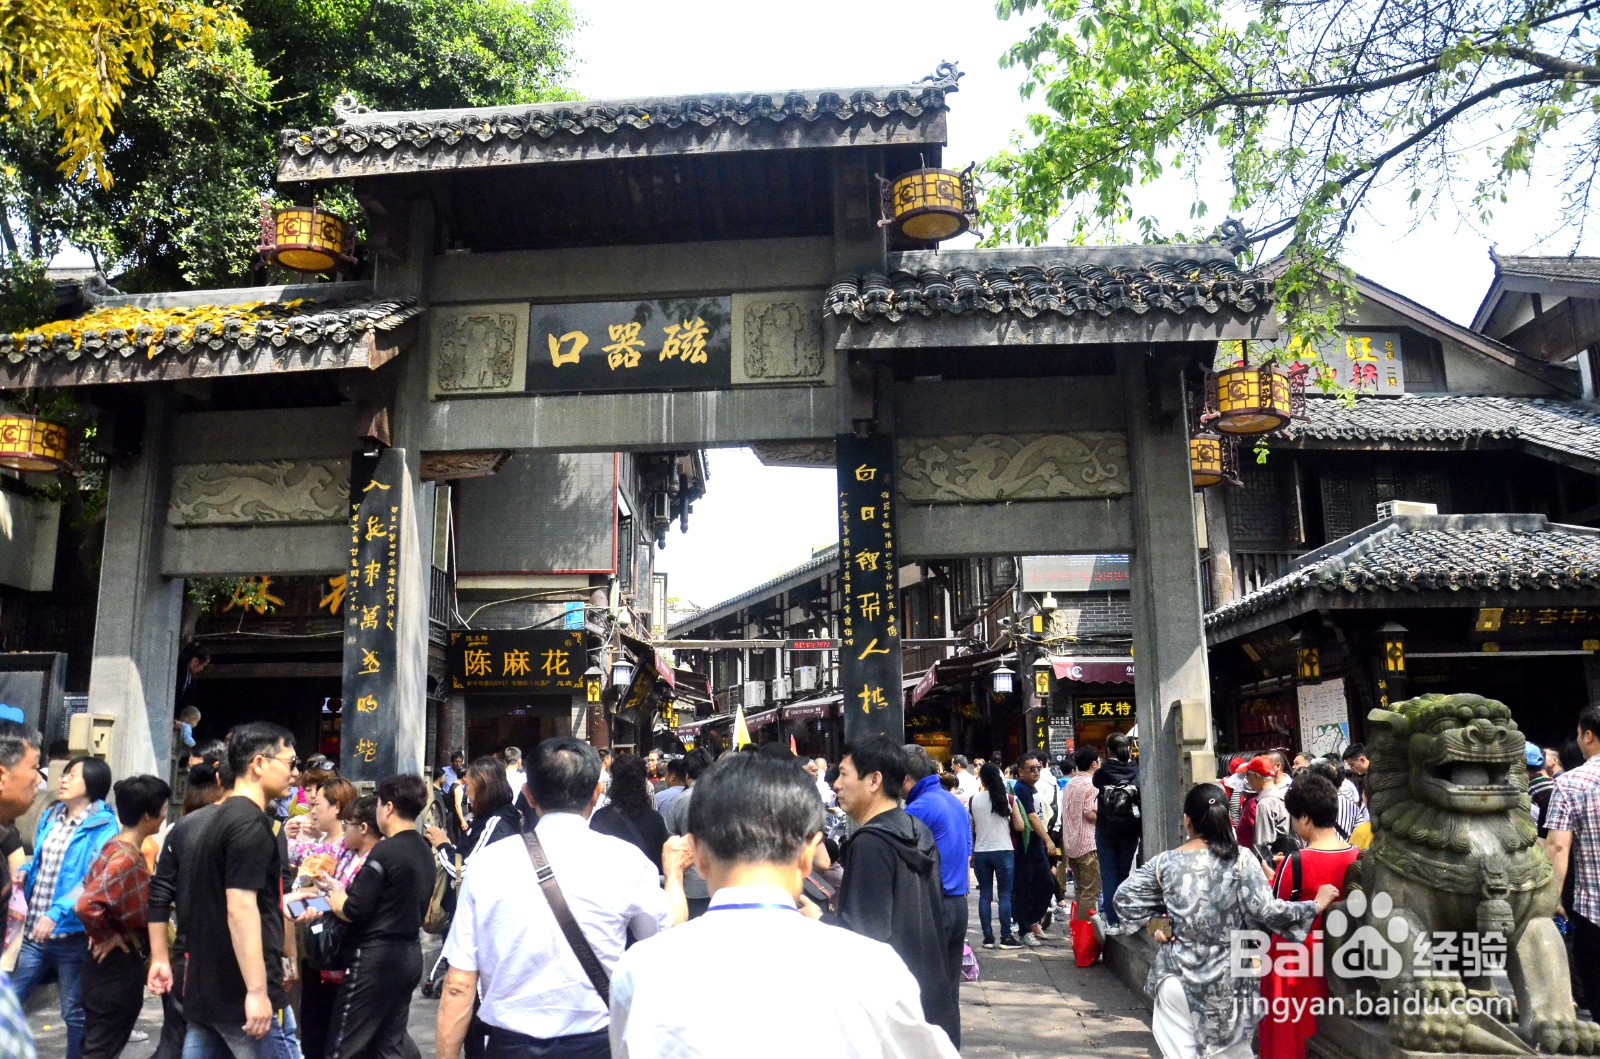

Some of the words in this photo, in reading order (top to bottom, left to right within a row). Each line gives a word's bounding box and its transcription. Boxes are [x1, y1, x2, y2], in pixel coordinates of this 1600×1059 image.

[464, 649, 570, 676] 陈麻花
[1079, 702, 1137, 717] 重庆特
